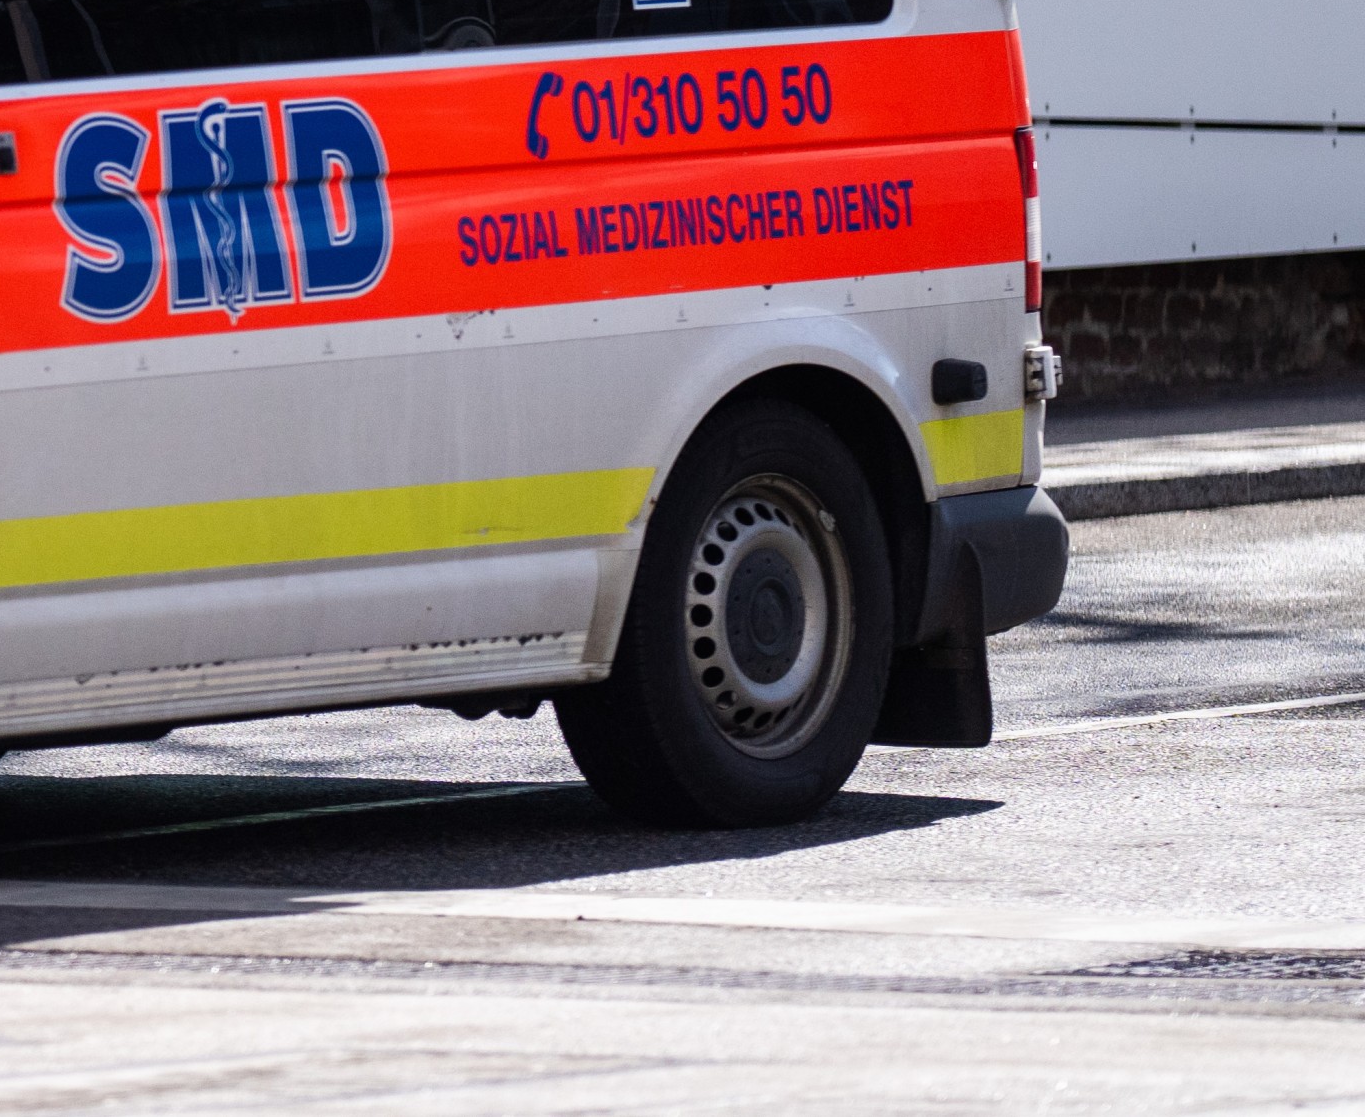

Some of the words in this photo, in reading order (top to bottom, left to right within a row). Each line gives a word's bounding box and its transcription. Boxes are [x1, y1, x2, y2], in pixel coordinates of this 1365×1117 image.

[572, 72, 704, 144] 01/310
[716, 67, 768, 132] 50
[781, 62, 832, 127] 50
[53, 97, 394, 324] SMD
[458, 211, 569, 267] SOZIAL
[575, 189, 804, 255] MEDIZINISCHER
[812, 179, 914, 235] DIENST
